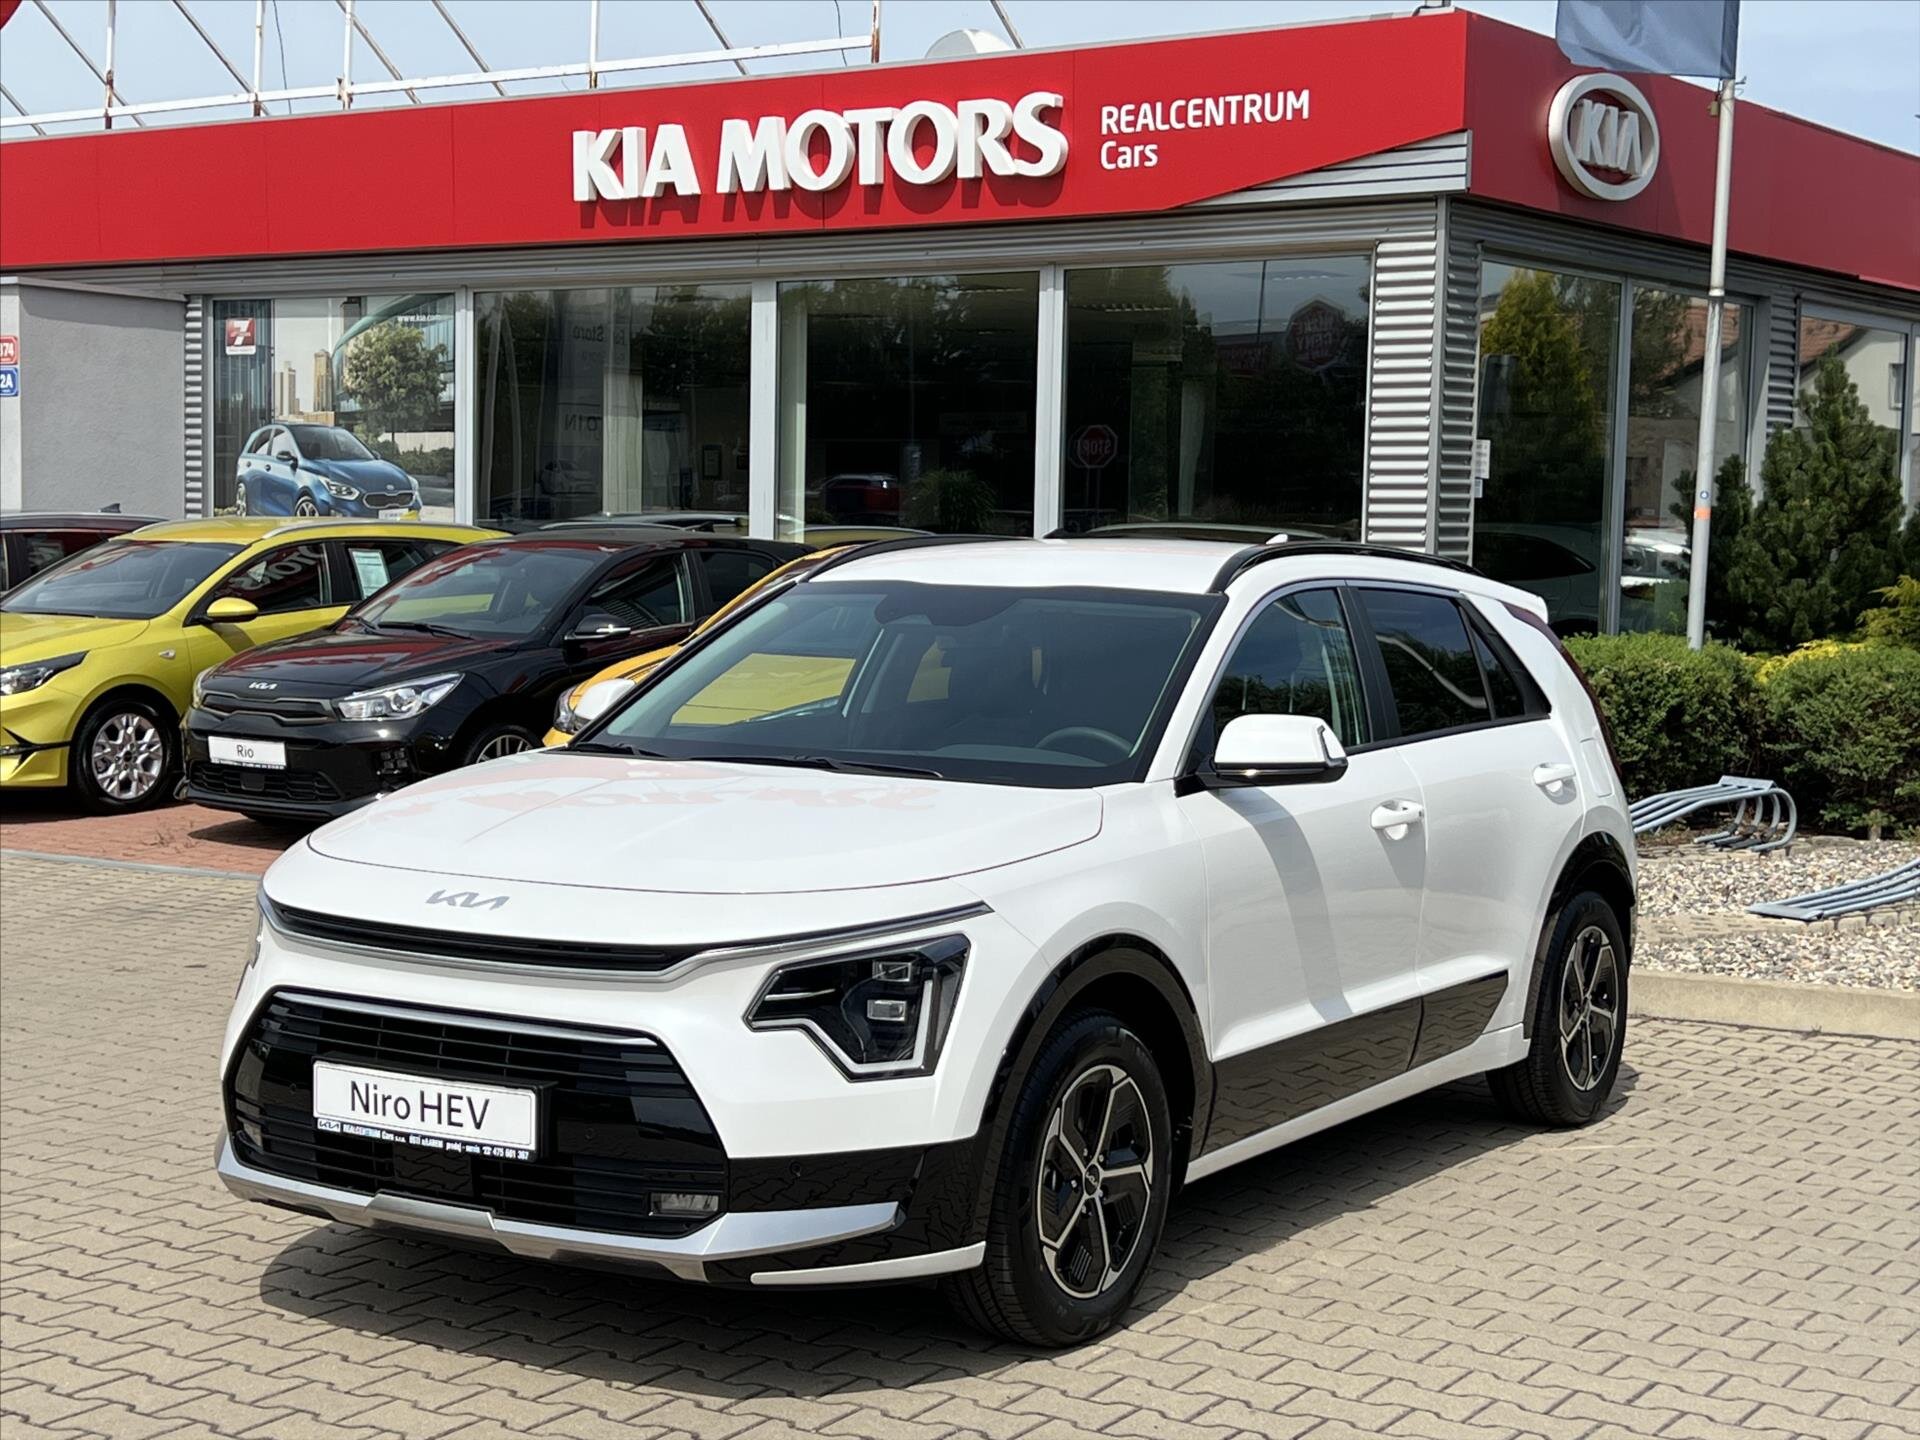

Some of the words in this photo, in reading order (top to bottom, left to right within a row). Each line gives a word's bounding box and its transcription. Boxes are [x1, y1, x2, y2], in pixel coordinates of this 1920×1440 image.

[1101, 89, 1310, 135] REALCENTRUM
[573, 124, 701, 202] KIA
[716, 91, 1069, 193] MOTORS
[1101, 140, 1158, 170] Cars
[1570, 98, 1643, 176] KIA
[236, 744, 254, 758] Rio
[350, 1080, 411, 1120] Niro
[420, 1089, 490, 1130] HEV
